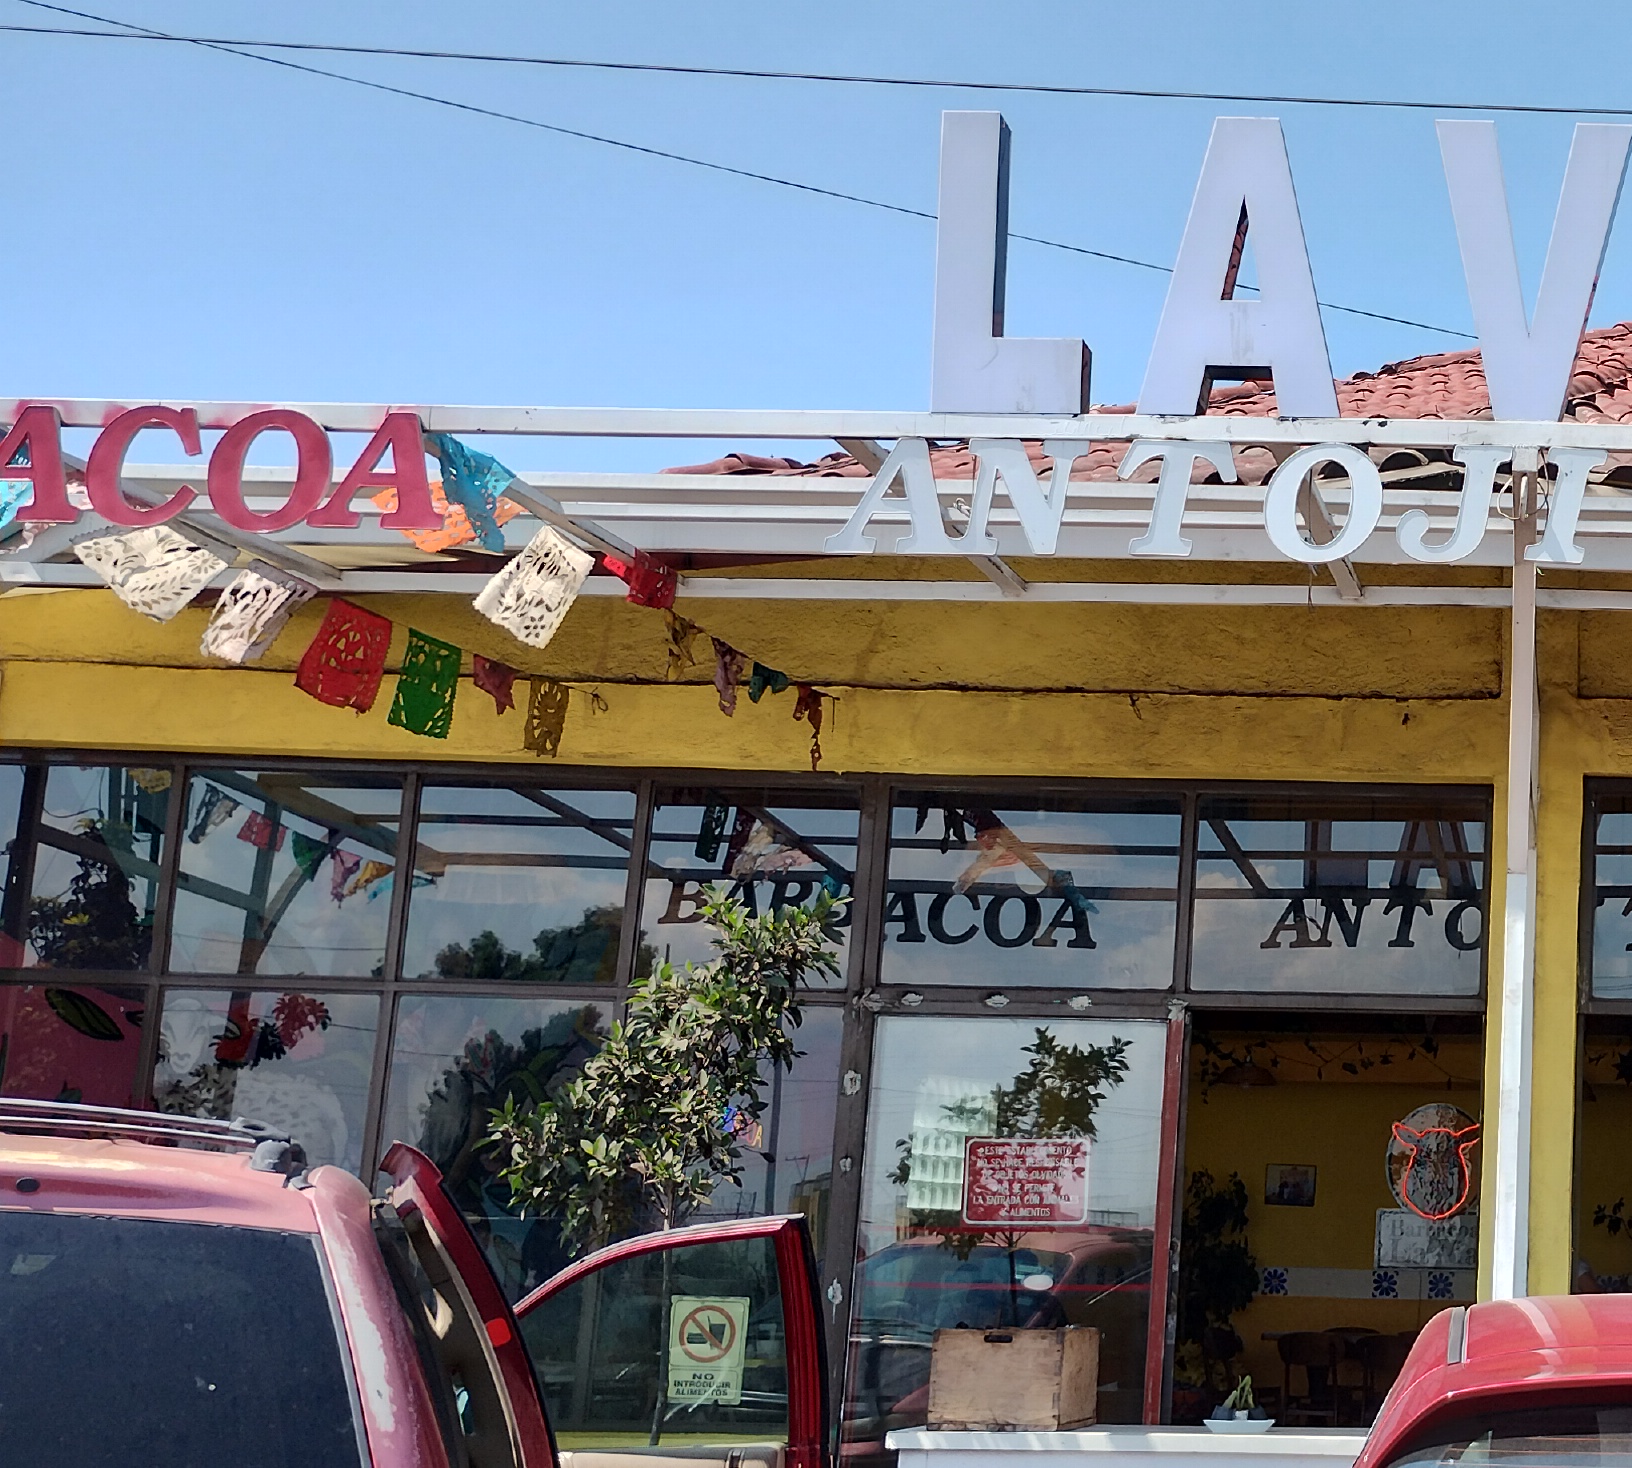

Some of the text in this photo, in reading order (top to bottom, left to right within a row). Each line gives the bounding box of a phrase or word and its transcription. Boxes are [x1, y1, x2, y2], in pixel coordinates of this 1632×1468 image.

[931, 110, 1340, 418] LA
[973, 1195, 984, 1204] LA
[987, 1195, 1021, 1205] ENTRADA
[673, 1379, 731, 1389] INTRODUCIR
[675, 1388, 728, 1397] ALIMENTOS
